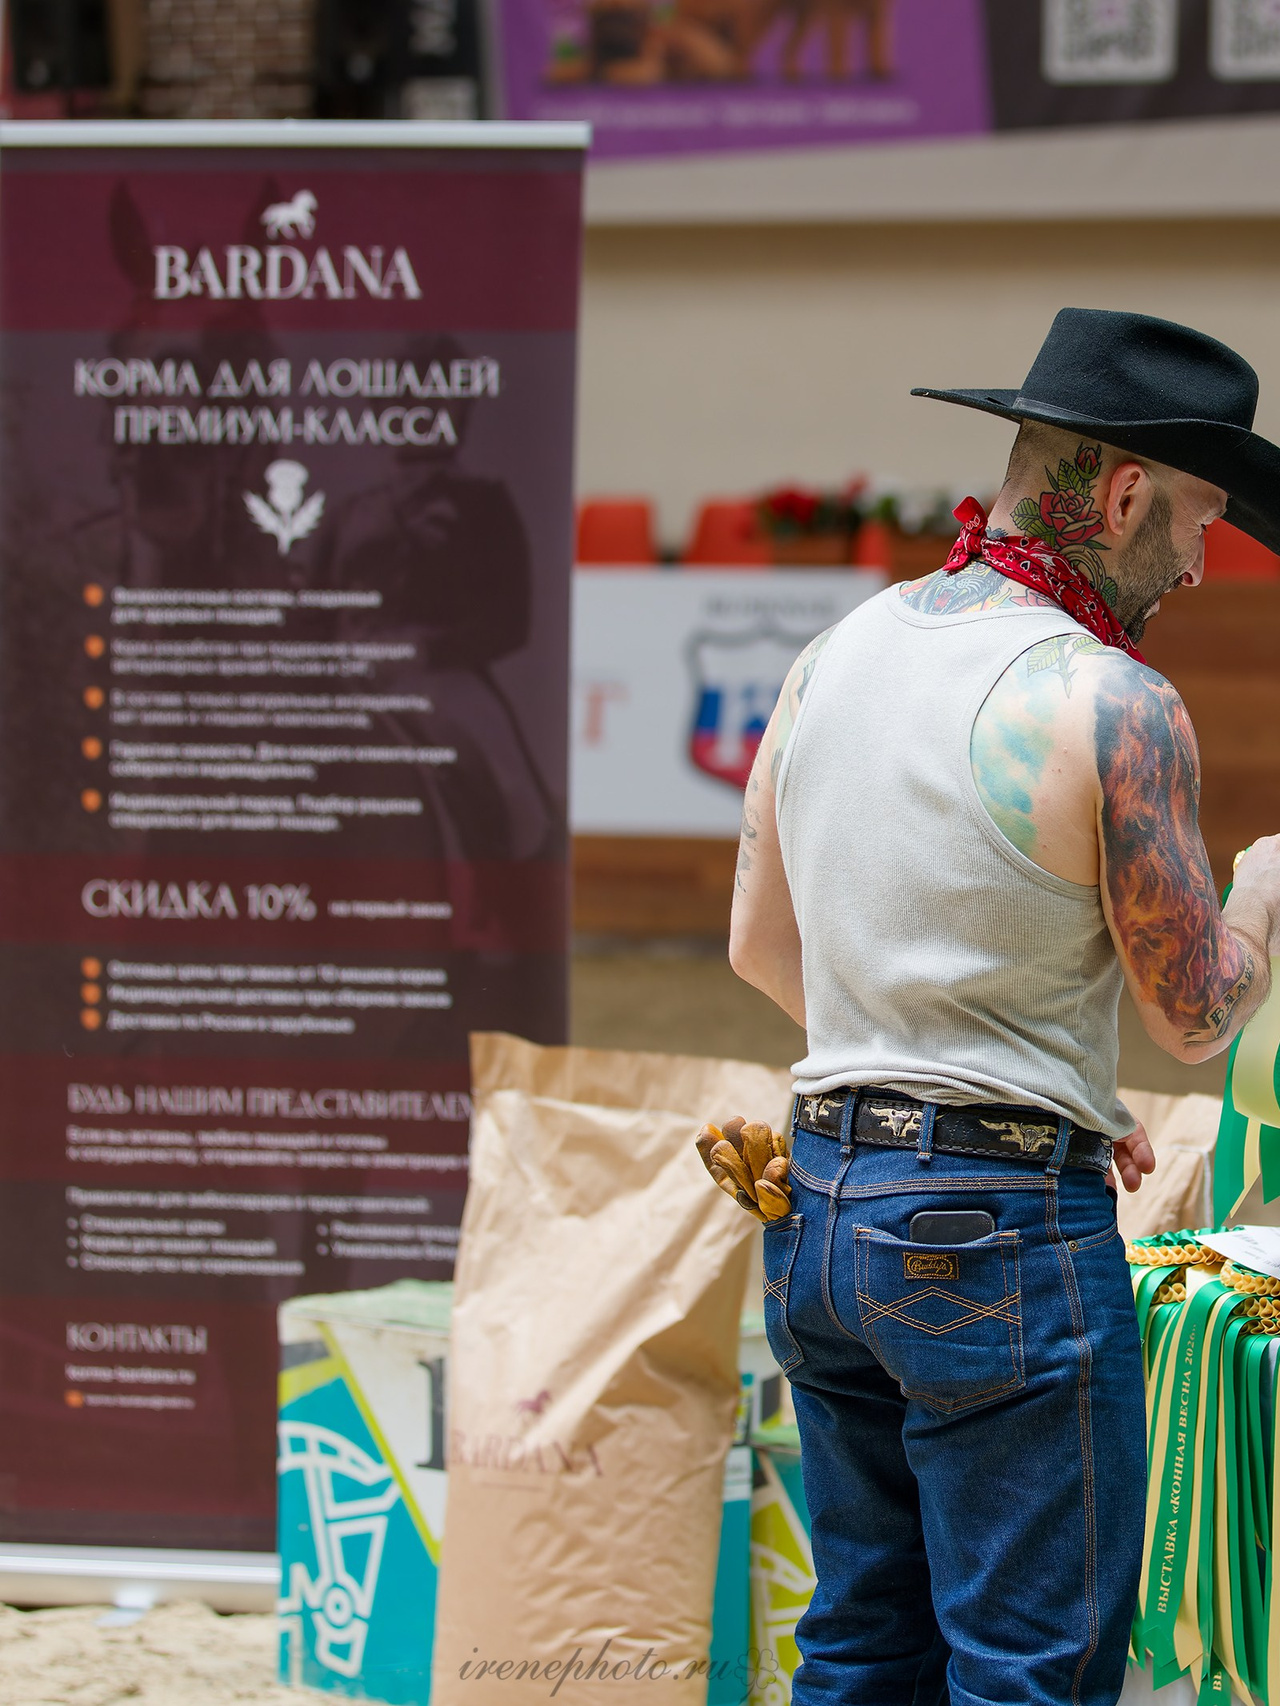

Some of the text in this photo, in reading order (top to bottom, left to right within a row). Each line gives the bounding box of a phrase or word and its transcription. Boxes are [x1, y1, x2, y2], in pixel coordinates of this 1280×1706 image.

[154, 245, 421, 300] BARDANA
[74, 357, 500, 397] КОРМА ДЛЯ ЛОШАДЕЙ
[114, 406, 458, 445] ПРЕМИУМ-КЛАССА
[81, 879, 238, 920] СКИДКА
[244, 883, 317, 921] 10%
[67, 1083, 131, 1114] БУДЬ
[135, 1085, 243, 1117] НАШИМ
[66, 1323, 207, 1354] КОНТАКТЫ
[1157, 1519, 1179, 1613] ВЫСТАВКА
[1169, 1431, 1187, 1515] «КОННАЯ
[1178, 1370, 1192, 1428] ВЕСНА
